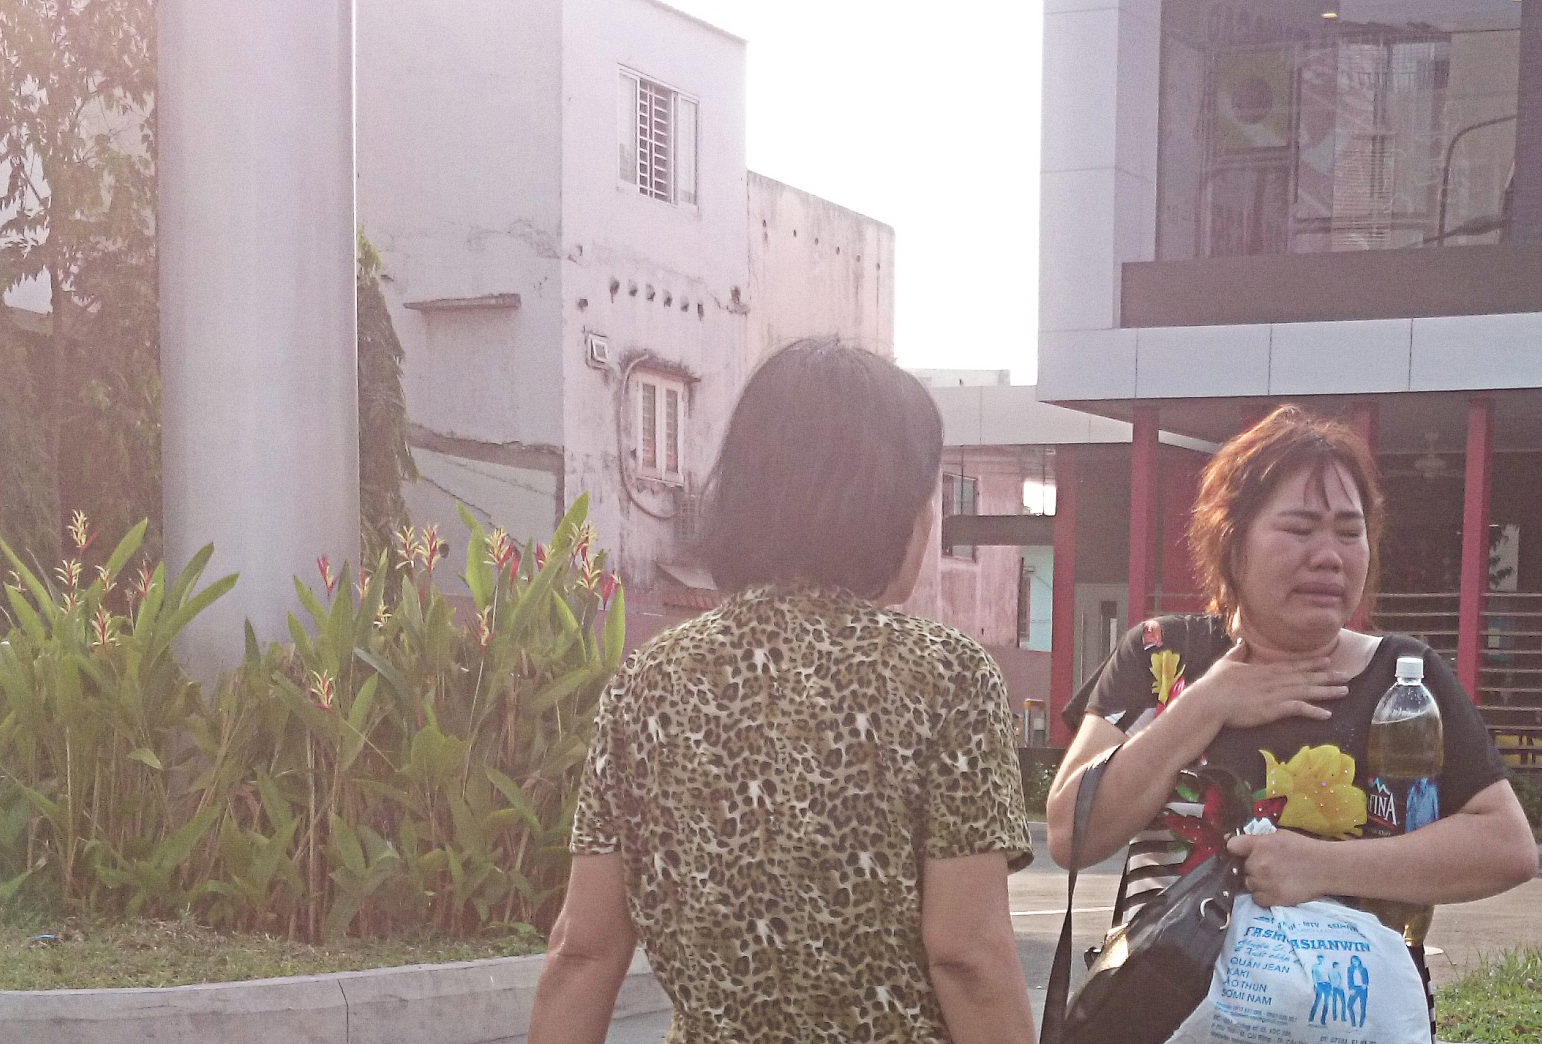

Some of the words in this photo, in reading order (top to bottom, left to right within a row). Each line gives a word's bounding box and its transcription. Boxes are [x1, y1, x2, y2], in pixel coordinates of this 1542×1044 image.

[1291, 939, 1371, 952] ASIANWIN
[1226, 967, 1250, 979] KAKI
[1263, 963, 1290, 973] JEAN
[1241, 980, 1267, 992] THUN
[1247, 993, 1272, 1006] NAM
